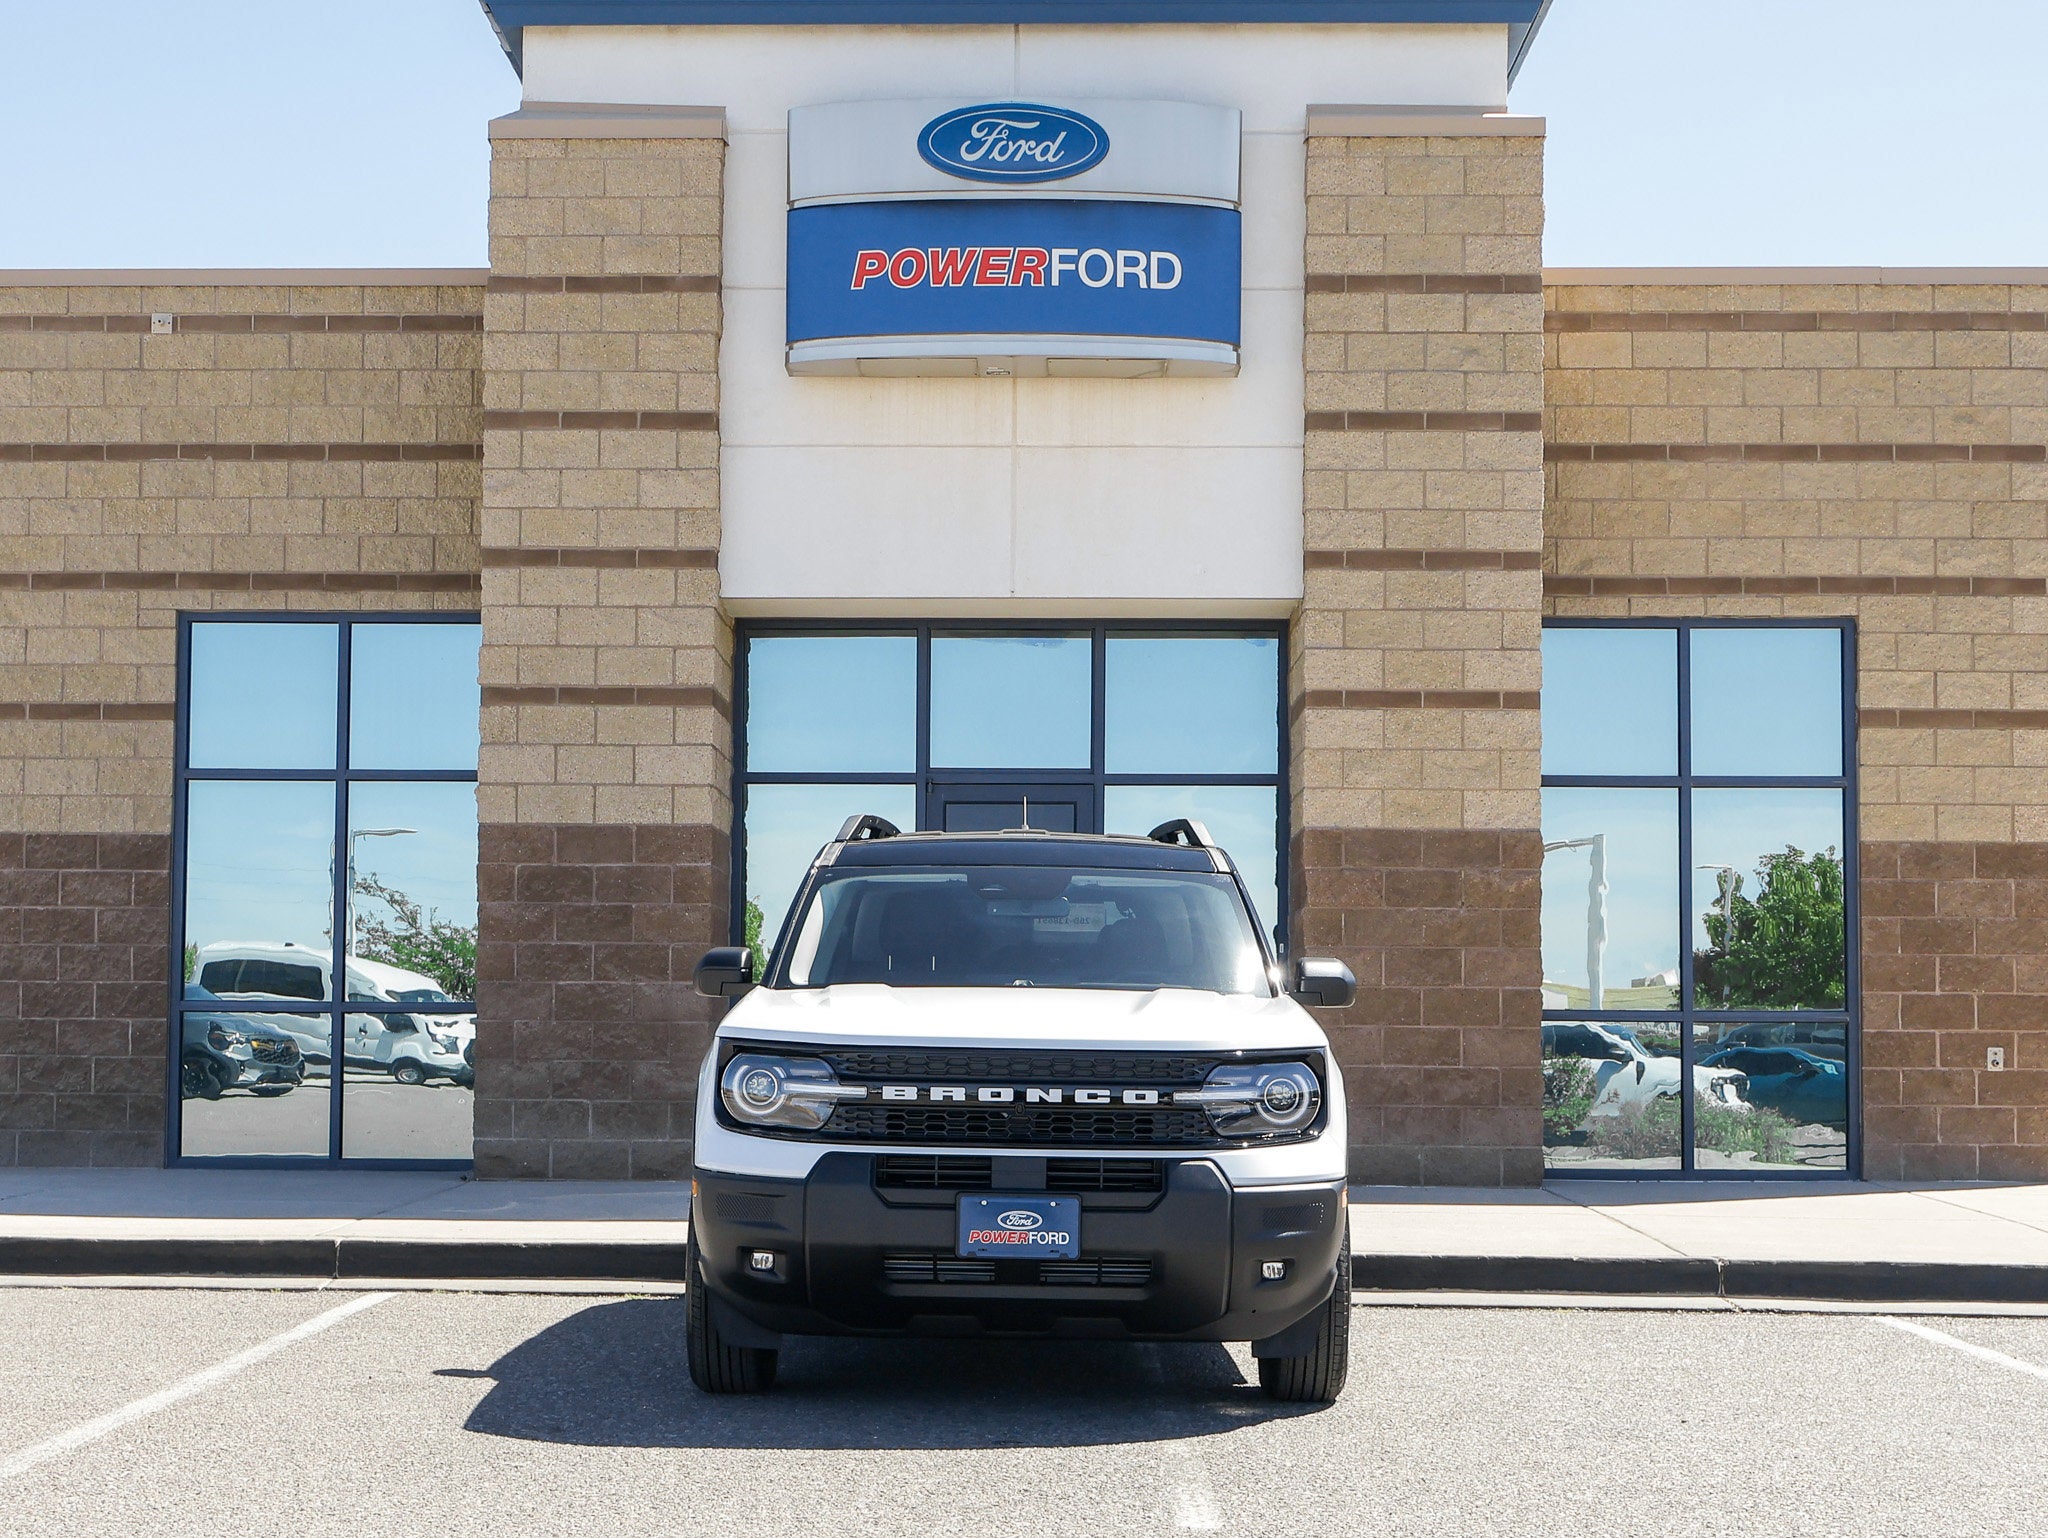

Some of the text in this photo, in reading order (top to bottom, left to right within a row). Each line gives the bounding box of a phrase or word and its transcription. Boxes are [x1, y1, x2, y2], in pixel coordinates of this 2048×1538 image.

[960, 118, 1067, 164] Ford
[850, 246, 1183, 291] POWERFORD
[881, 1085, 1159, 1104] BRONCO
[1006, 1213, 1033, 1226] Ford
[968, 1229, 1070, 1245] POWERFORD
